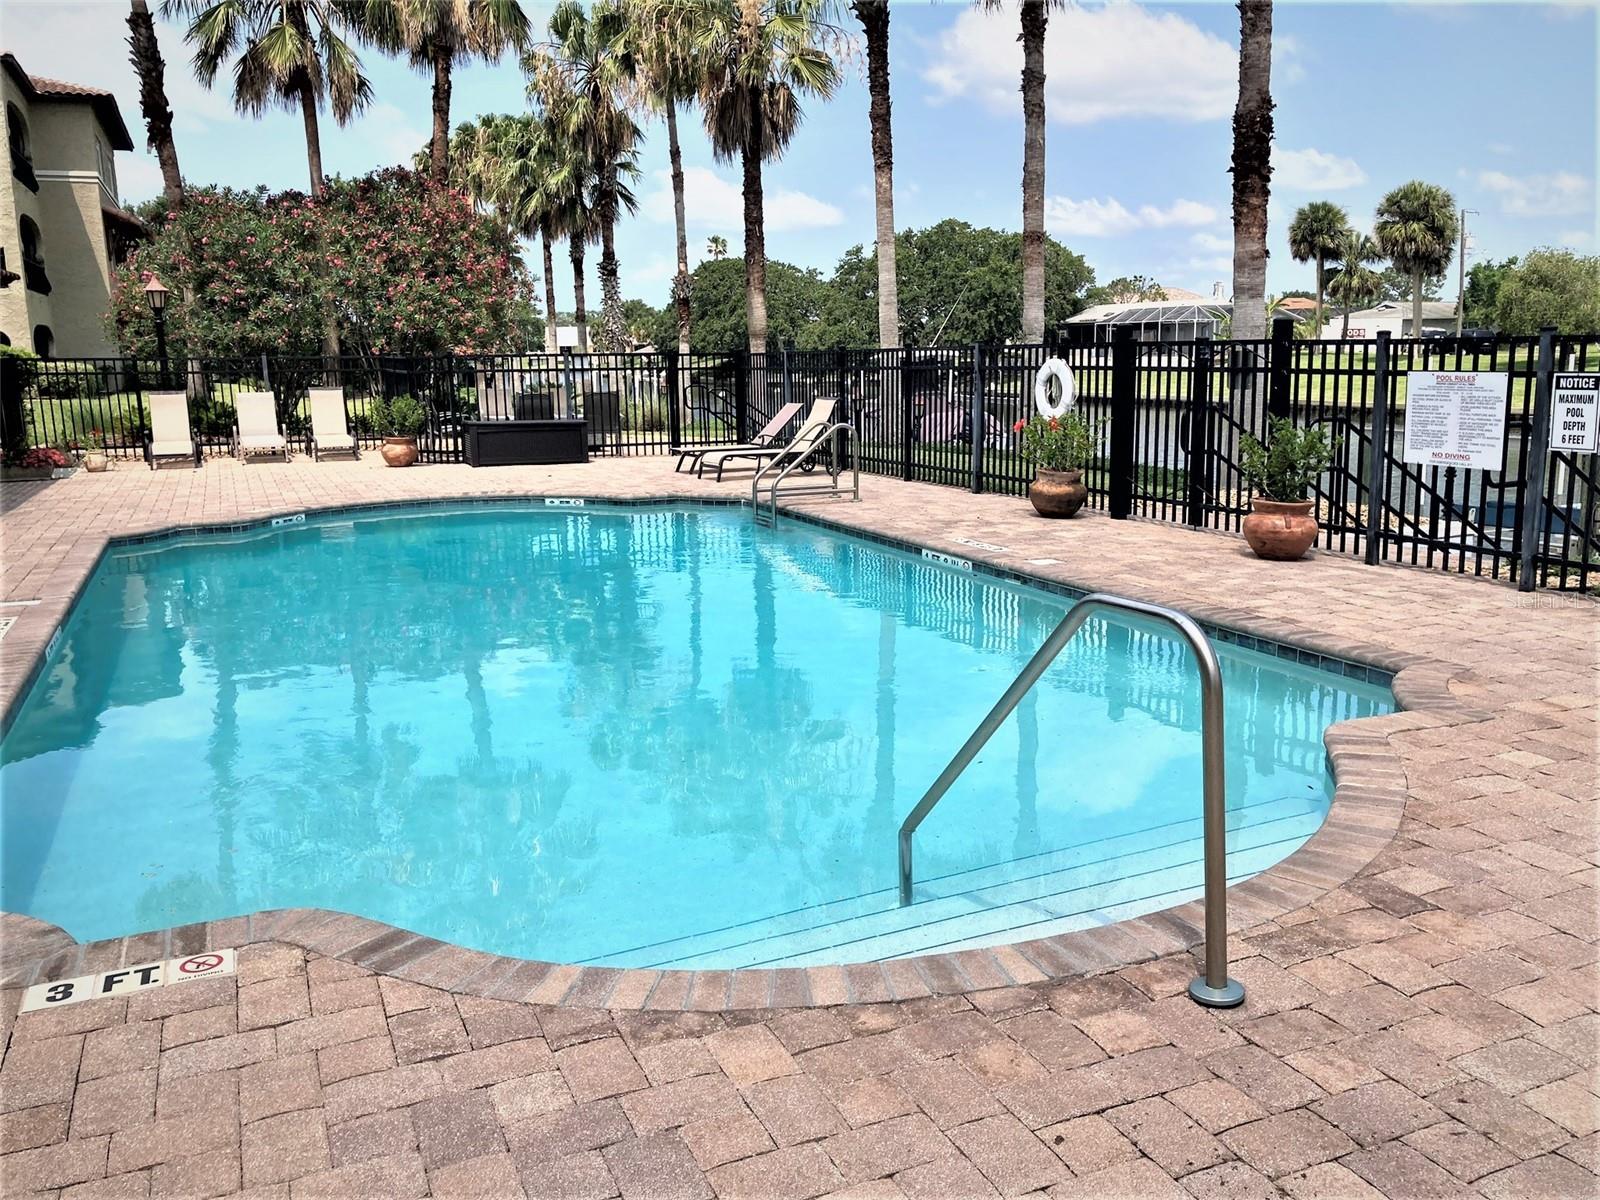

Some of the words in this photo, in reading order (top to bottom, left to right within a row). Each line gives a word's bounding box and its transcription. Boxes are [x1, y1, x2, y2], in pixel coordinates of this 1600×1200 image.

[1560, 377, 1596, 388] NOTICE
[1558, 394, 1594, 404] MAXIMUM
[1566, 407, 1584, 417] POOL
[1563, 421, 1586, 431] DEPTH
[1561, 434, 1566, 443] 6
[1568, 434, 1585, 444] FEET
[45, 983, 74, 1002] 3
[102, 965, 160, 993] FT.
